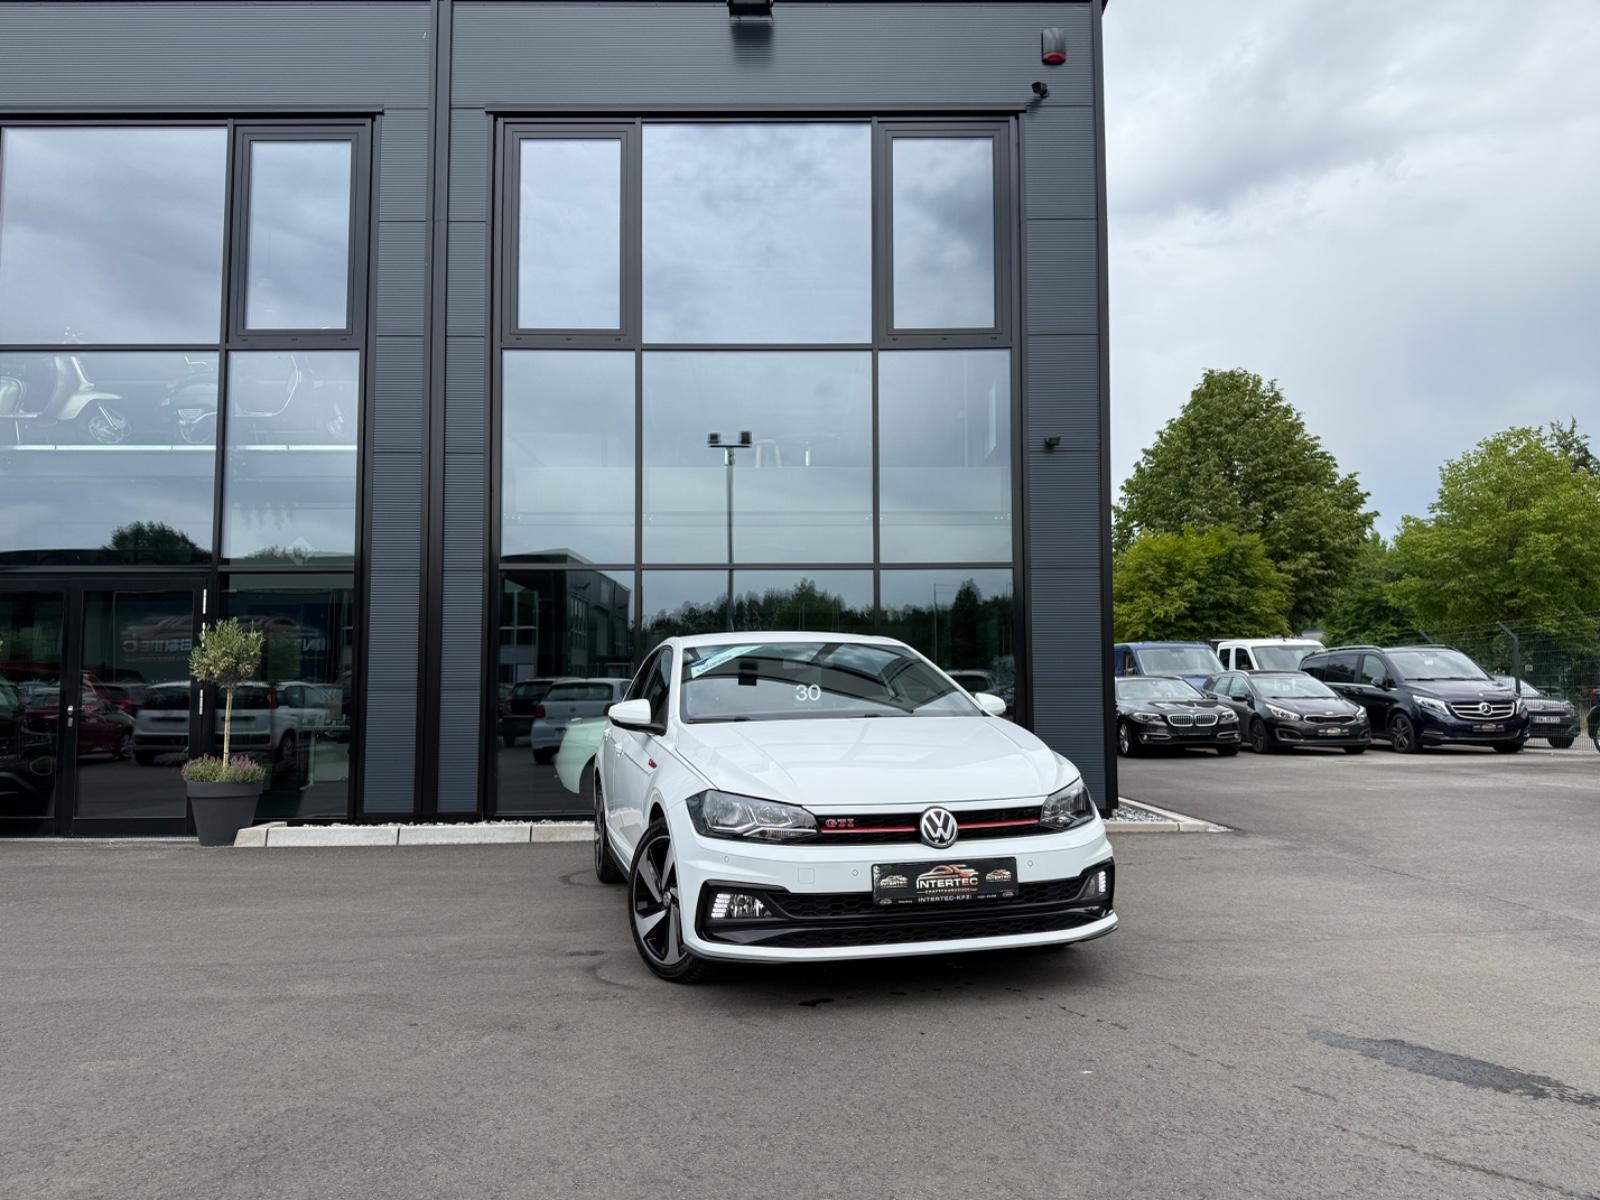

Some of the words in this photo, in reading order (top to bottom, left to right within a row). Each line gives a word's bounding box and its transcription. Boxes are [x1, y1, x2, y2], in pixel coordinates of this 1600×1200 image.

[795, 683, 821, 702] 30
[825, 818, 854, 829] GTI
[916, 877, 978, 889] INTERTEC
